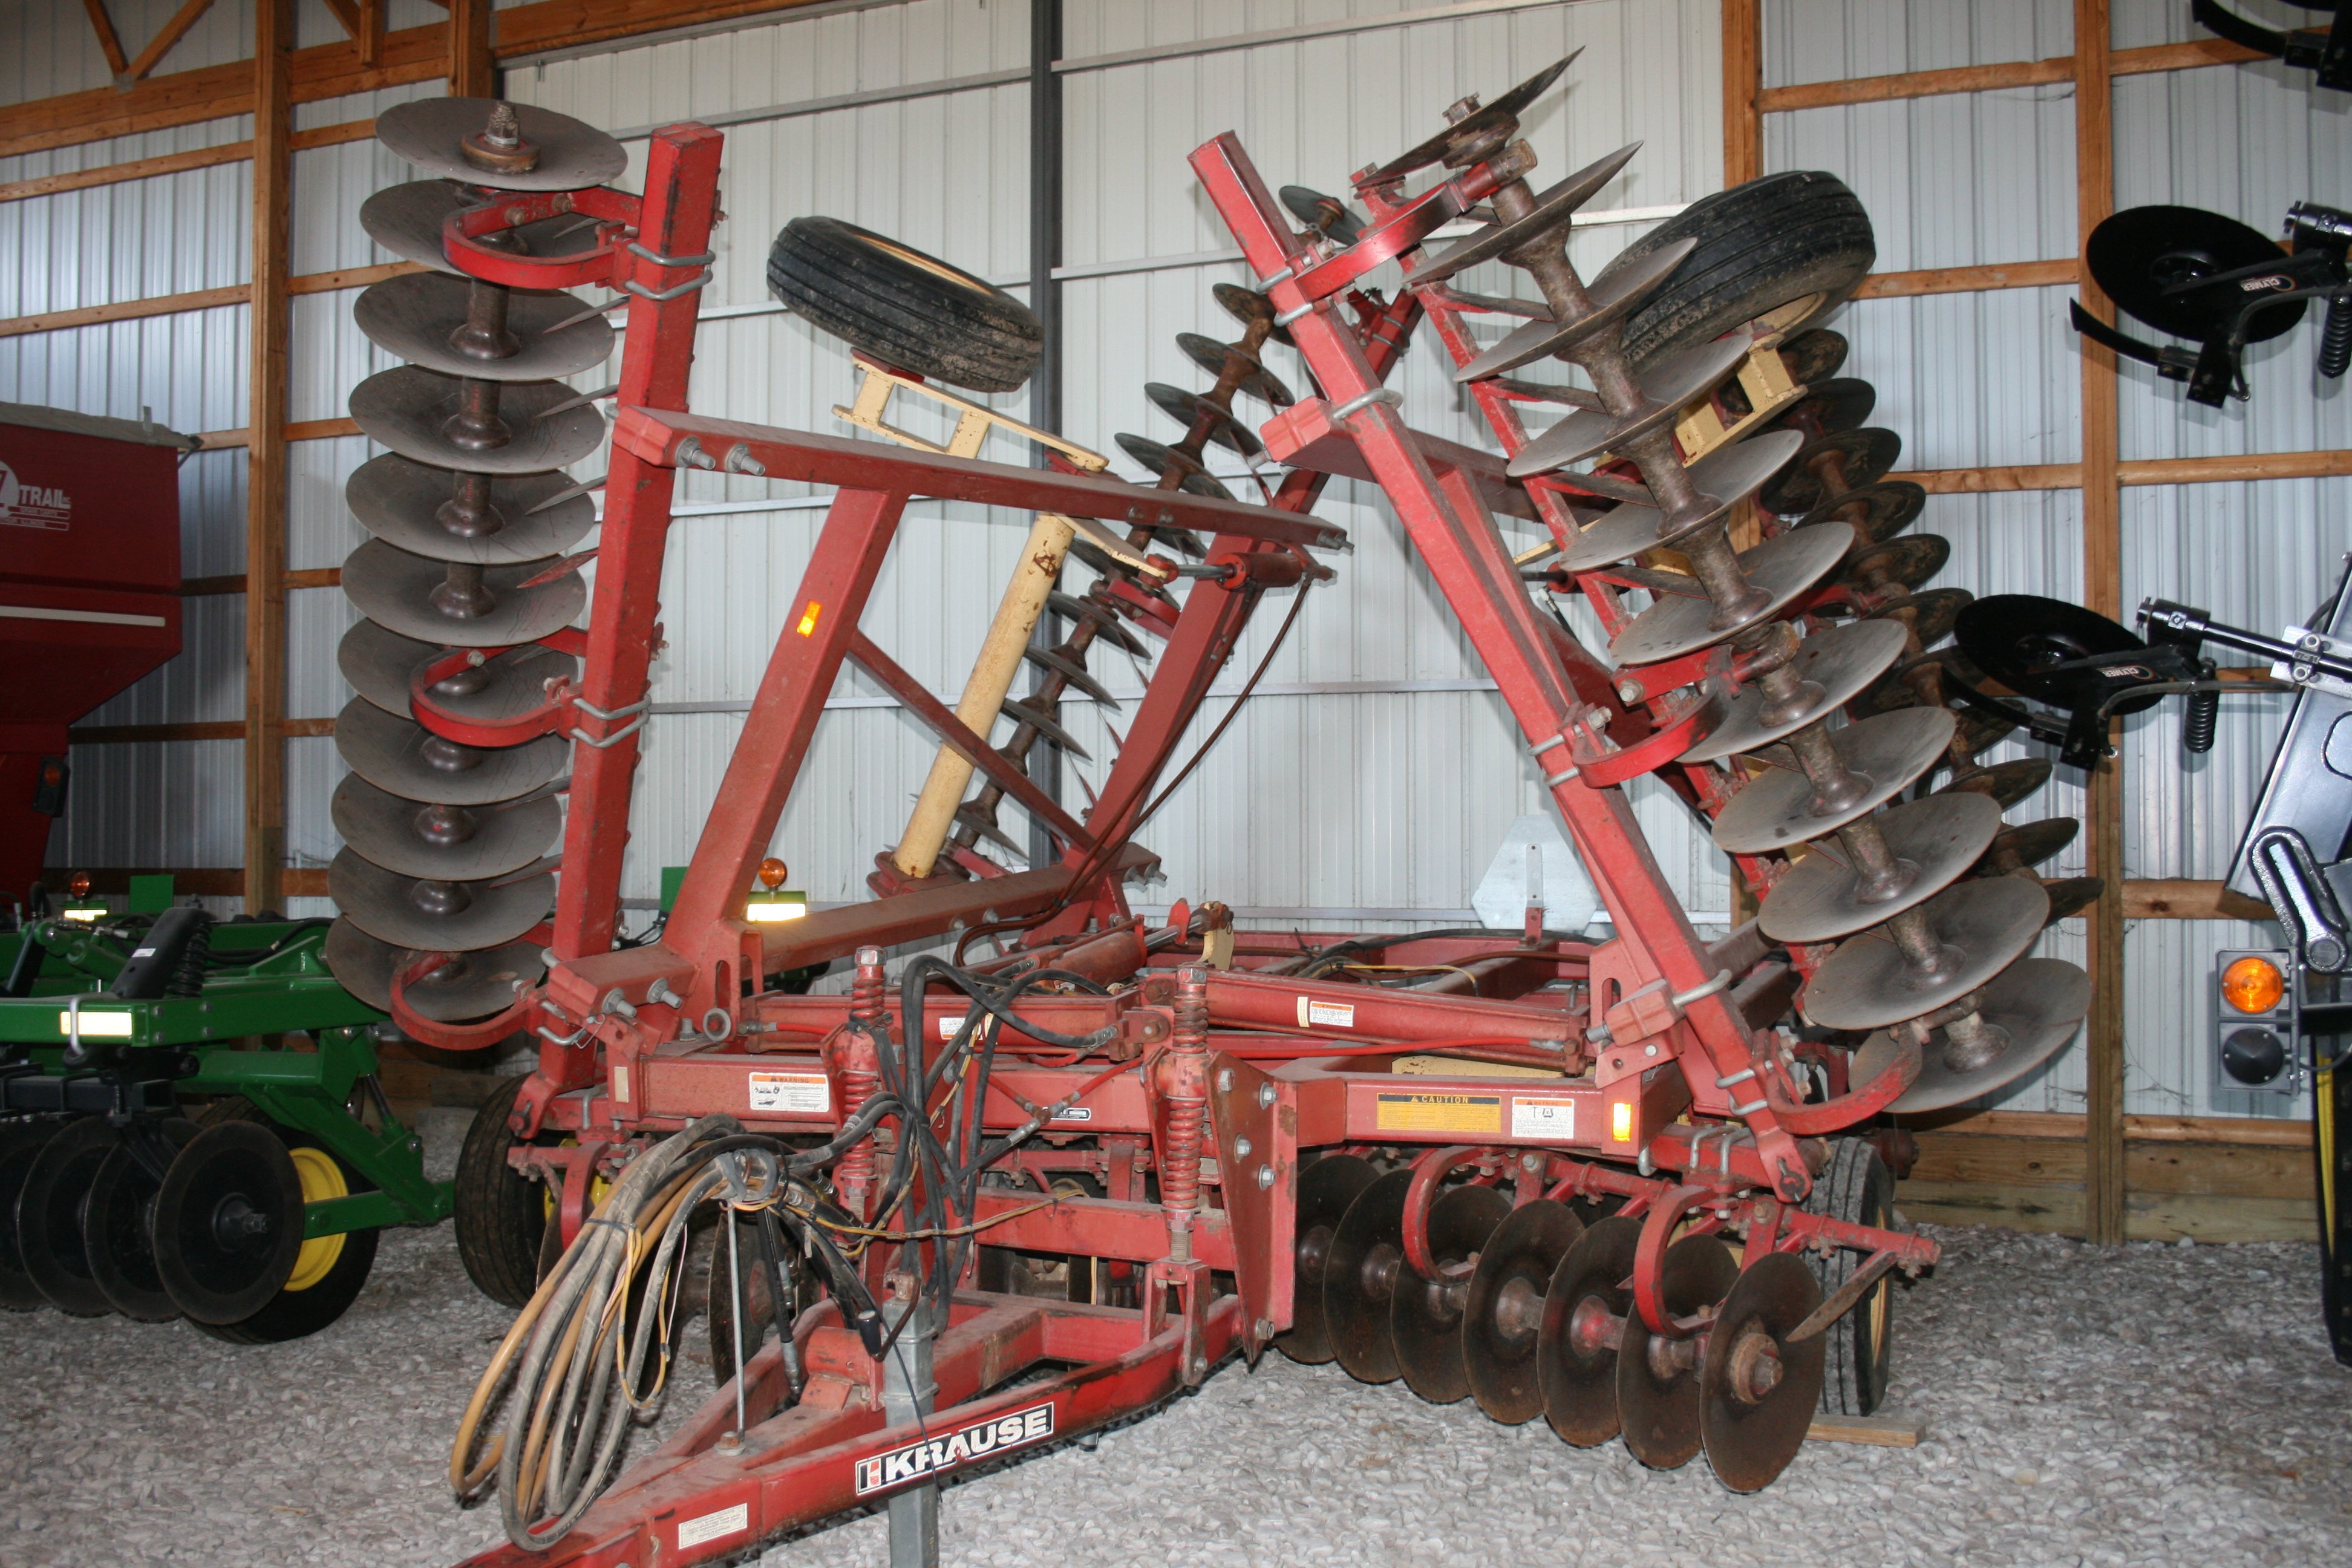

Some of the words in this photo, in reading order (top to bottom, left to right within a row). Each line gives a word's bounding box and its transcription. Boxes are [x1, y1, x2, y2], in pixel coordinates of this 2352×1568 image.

[19, 484, 71, 509] TRAIL
[1421, 1096, 1469, 1104] CAUTION
[885, 1408, 1047, 1482] KRAUSE
